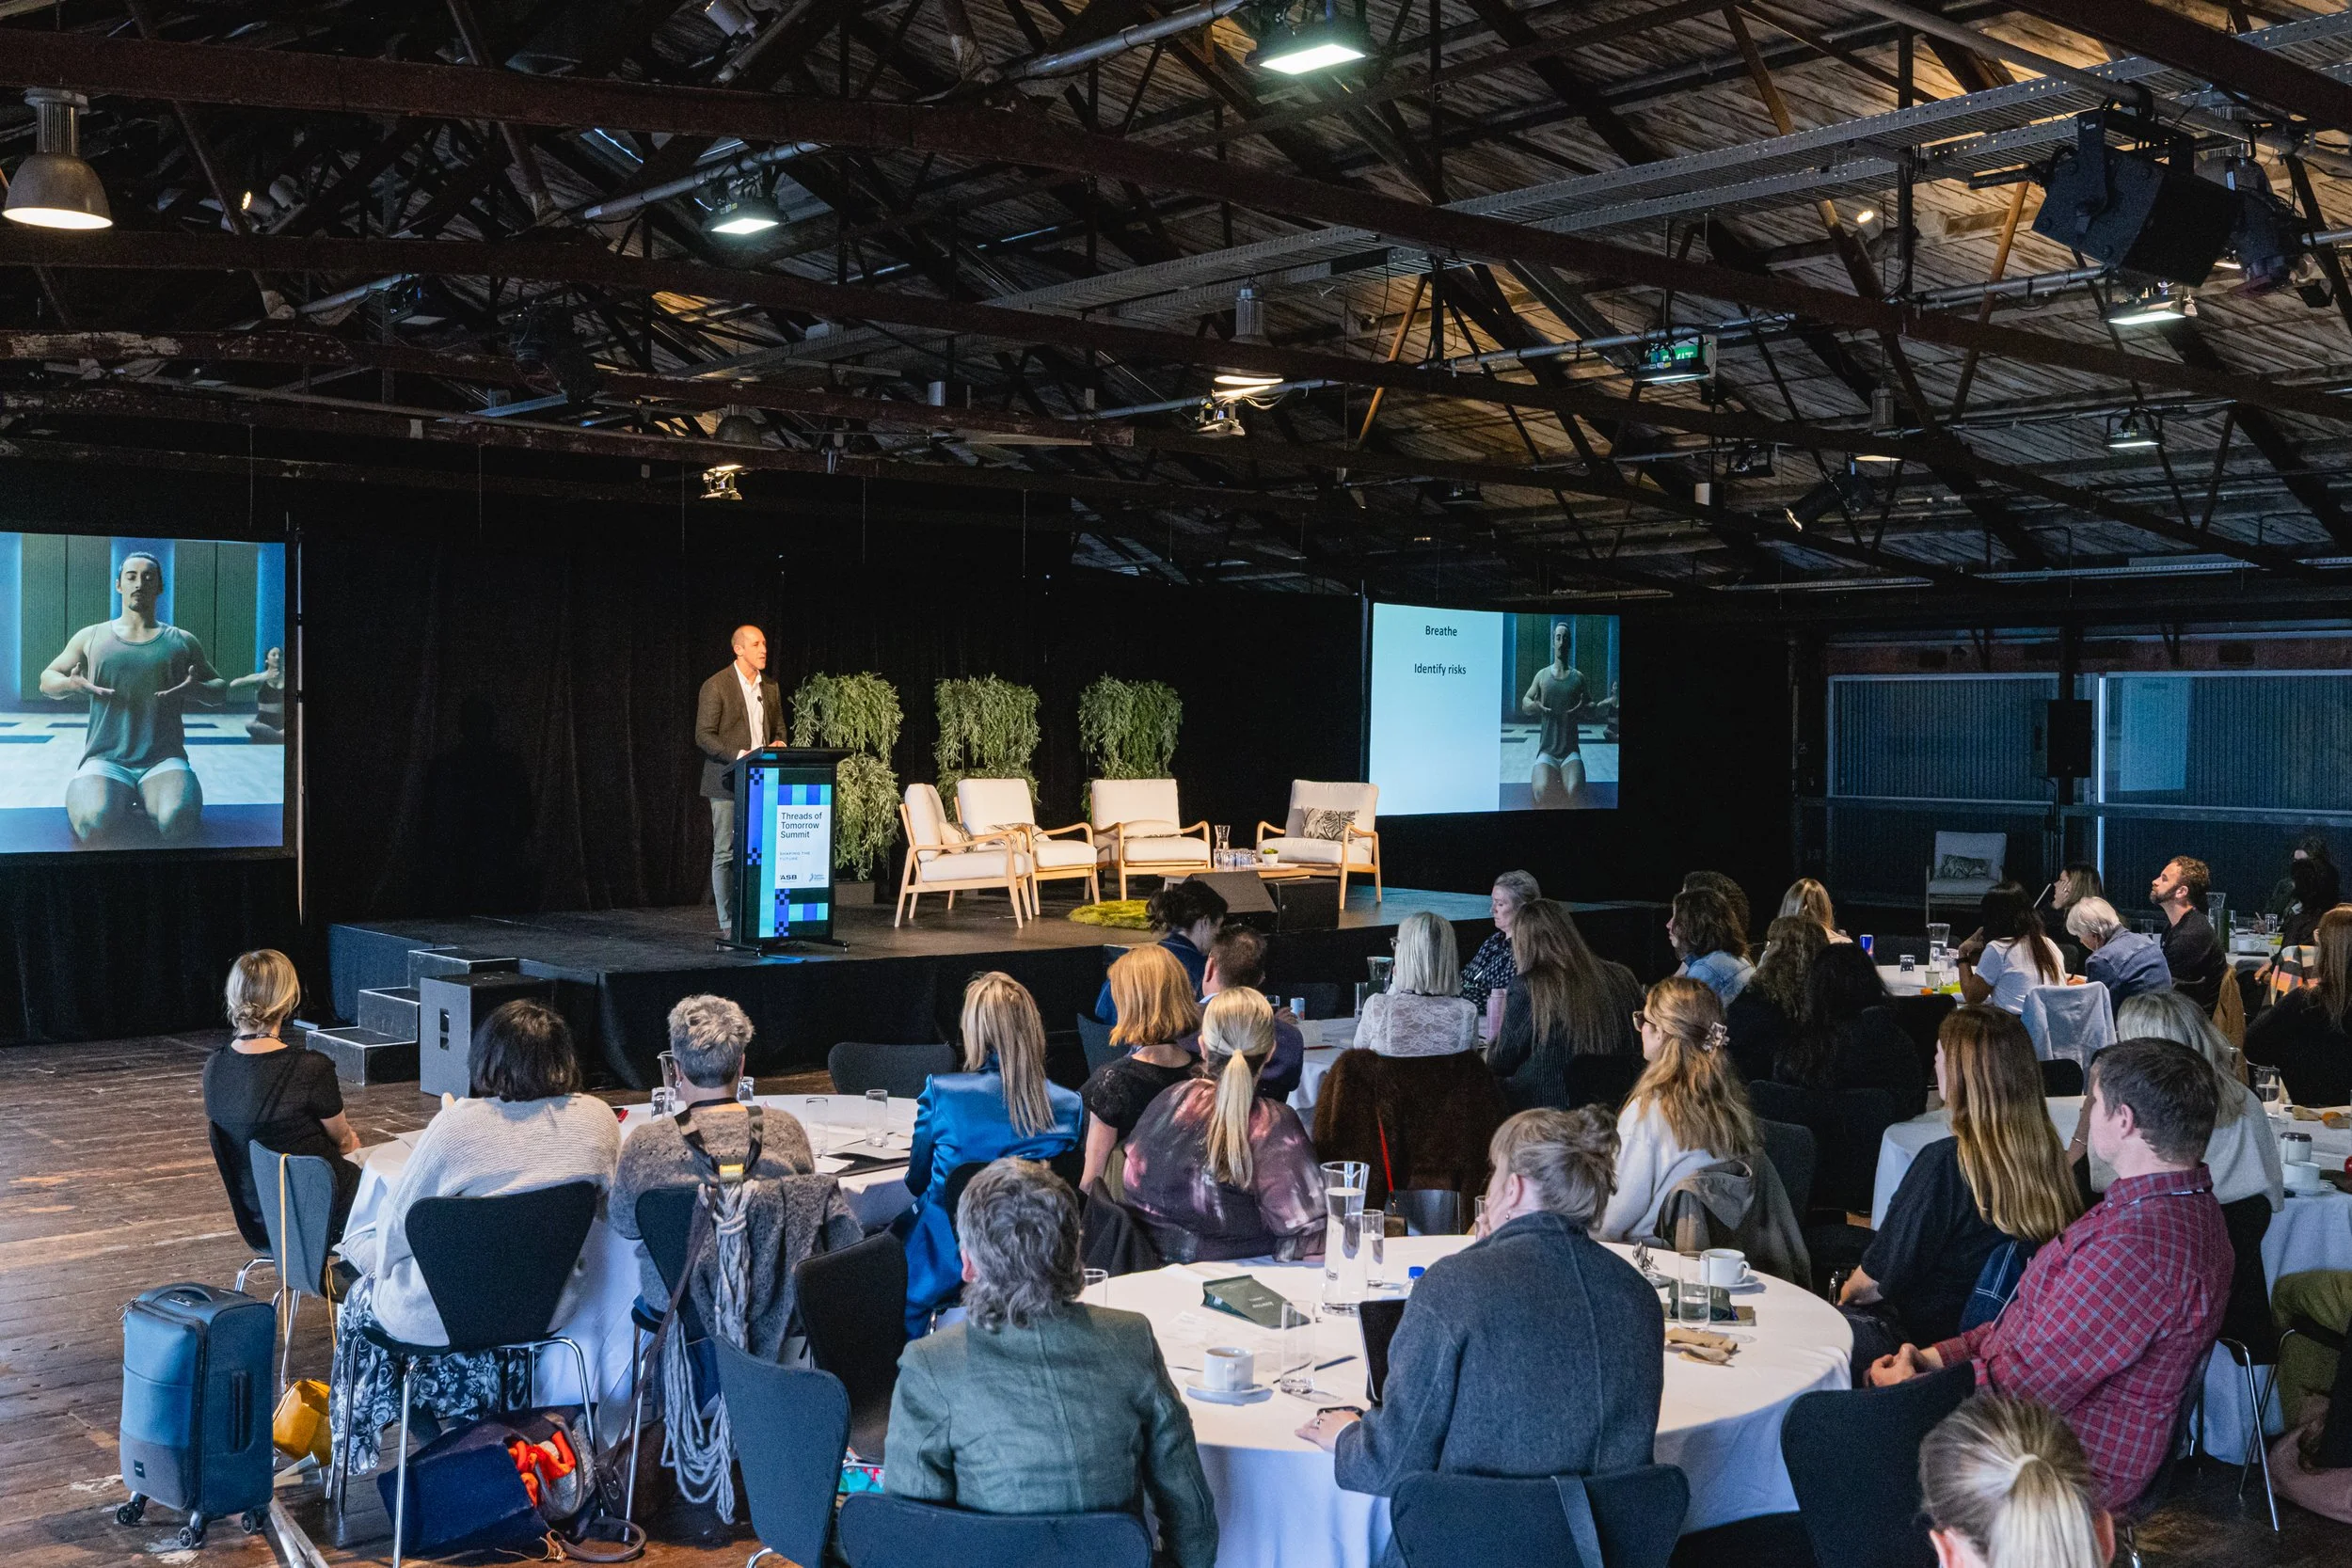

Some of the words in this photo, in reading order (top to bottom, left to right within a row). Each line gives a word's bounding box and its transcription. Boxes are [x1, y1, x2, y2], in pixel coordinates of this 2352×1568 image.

[1425, 625, 1457, 637] Breathe
[1414, 663, 1446, 676] Identify
[1448, 664, 1467, 675] risks
